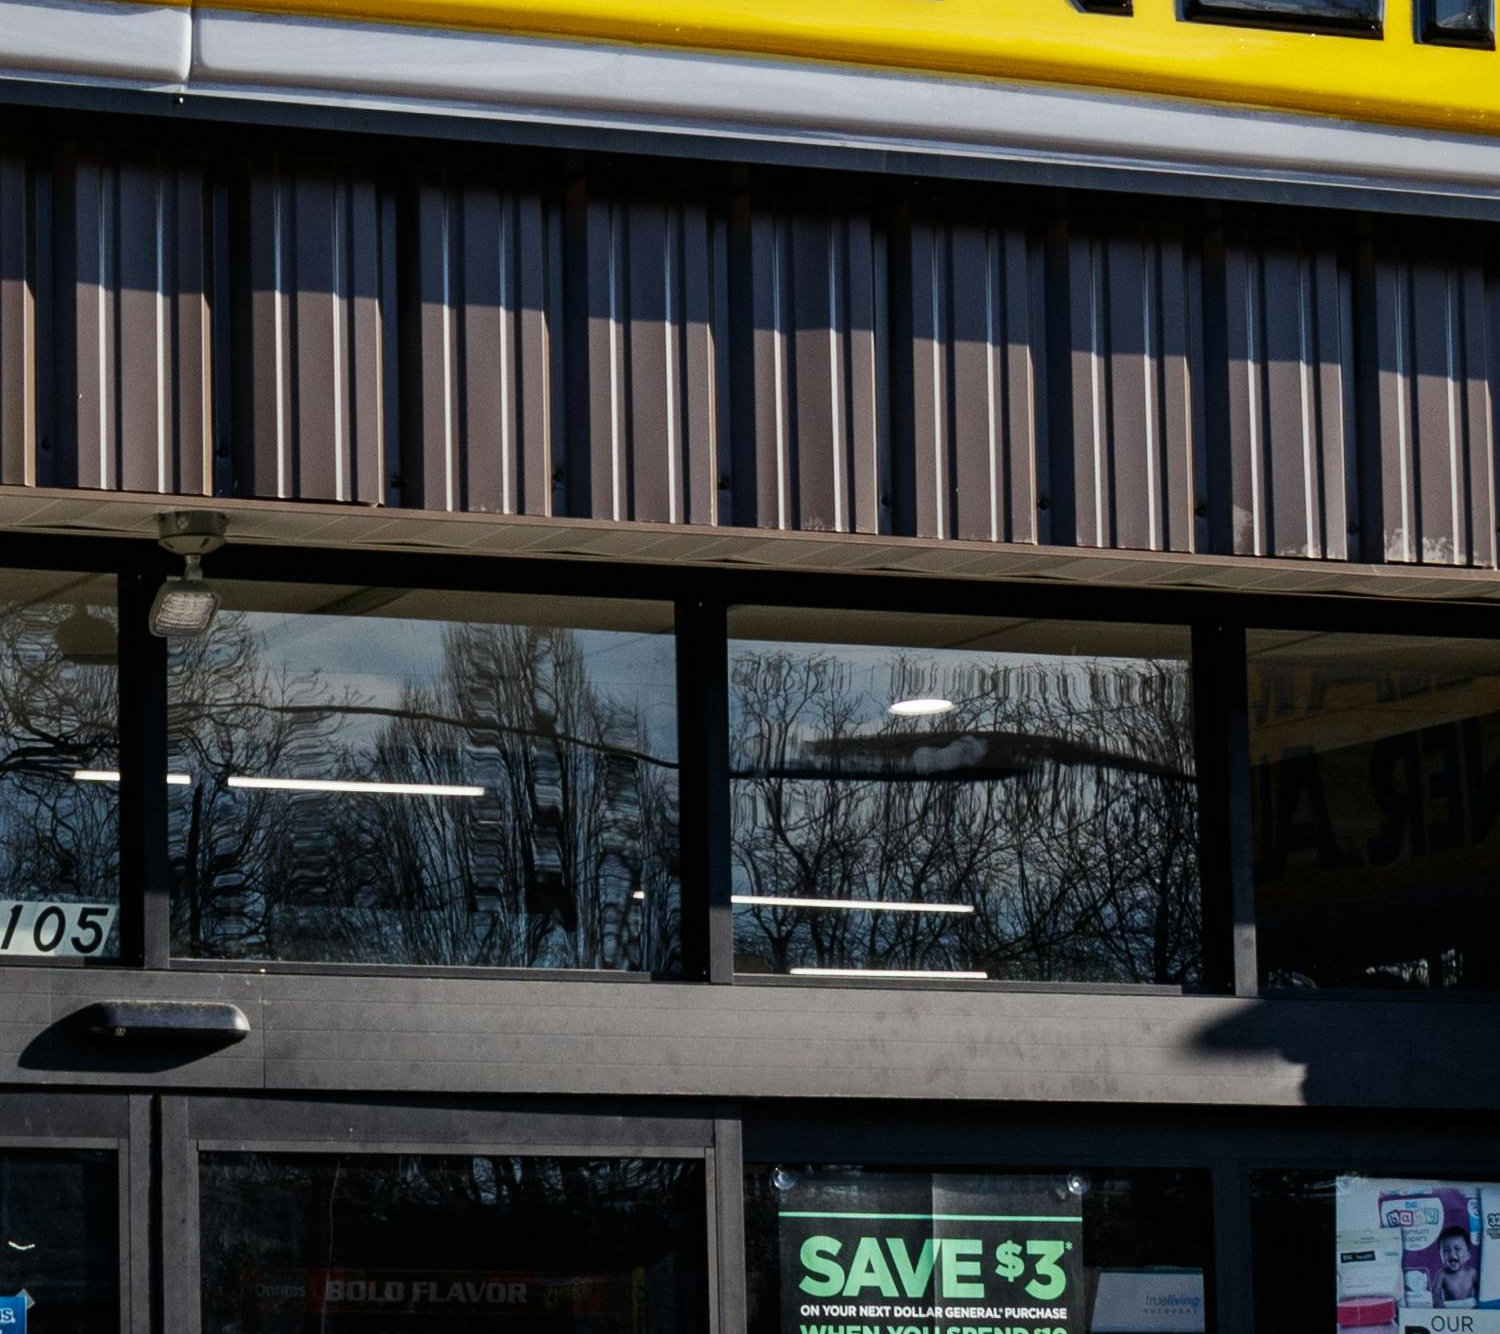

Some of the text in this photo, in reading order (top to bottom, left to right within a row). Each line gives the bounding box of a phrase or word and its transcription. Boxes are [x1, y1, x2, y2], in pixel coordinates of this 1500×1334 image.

[799, 1235, 985, 1299] SAVE
[325, 1280, 405, 1303] BOLD
[411, 1281, 528, 1305] FLAVOR
[800, 1305, 819, 1317] ON
[821, 1305, 857, 1317] YOUR
[859, 1306, 891, 1317] NEXT
[893, 1307, 943, 1318] DOLLAR
[1004, 1308, 1068, 1319] PURCHASE
[1431, 1315, 1474, 1332] OUR
